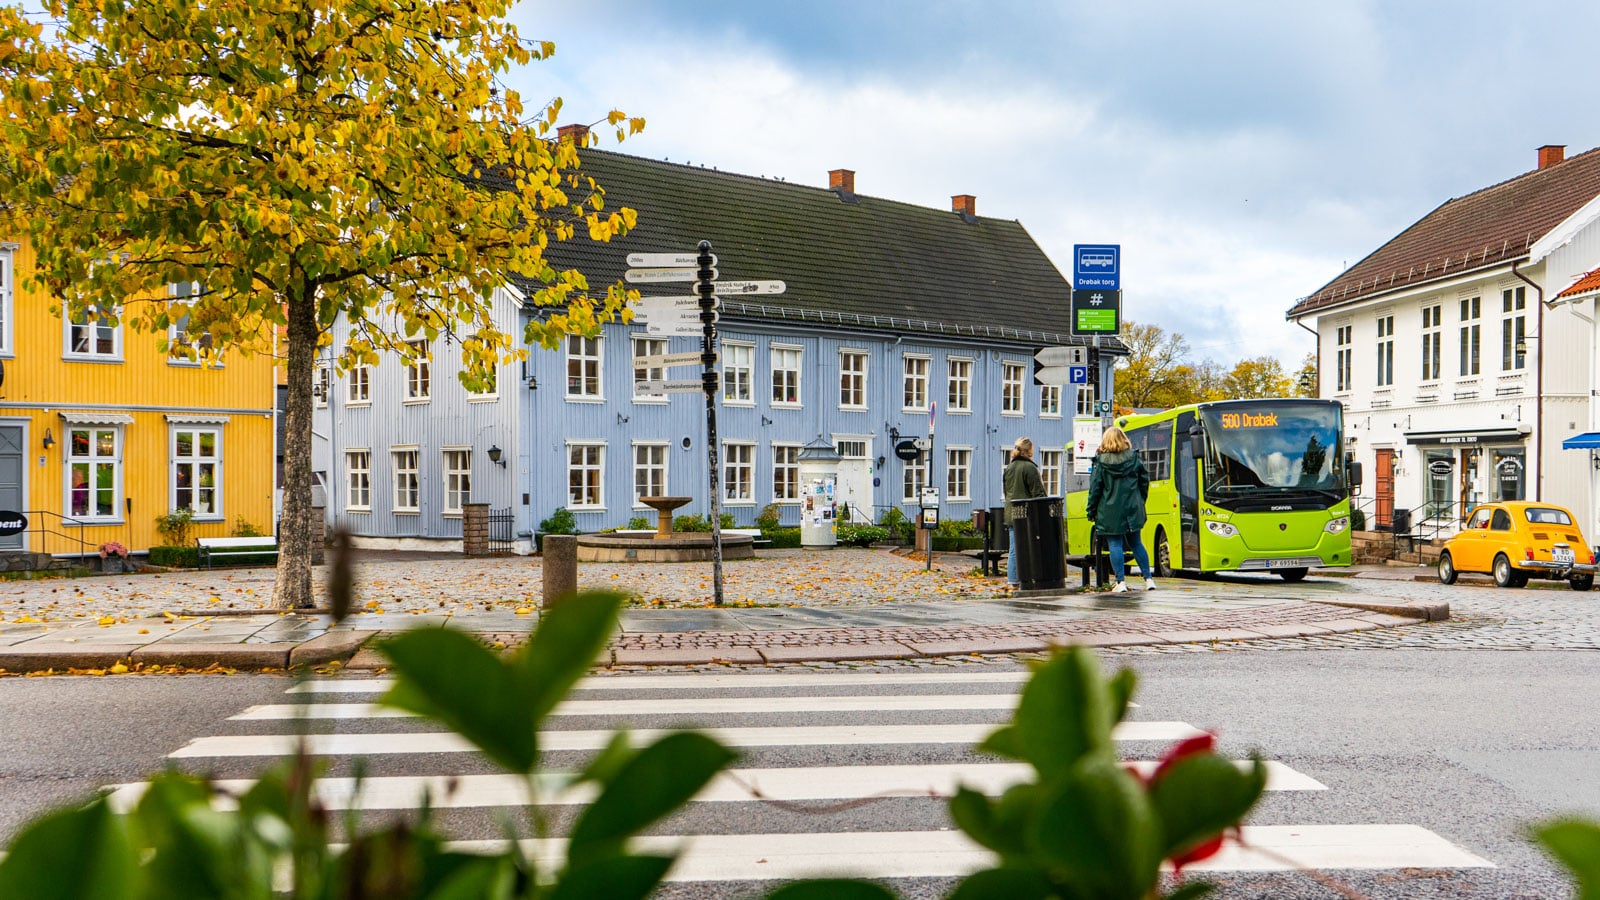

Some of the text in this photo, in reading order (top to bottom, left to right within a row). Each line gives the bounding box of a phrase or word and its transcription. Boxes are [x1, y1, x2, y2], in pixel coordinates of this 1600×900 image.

[1073, 368, 1084, 382] P
[1221, 411, 1279, 429] 500 Drøbak
